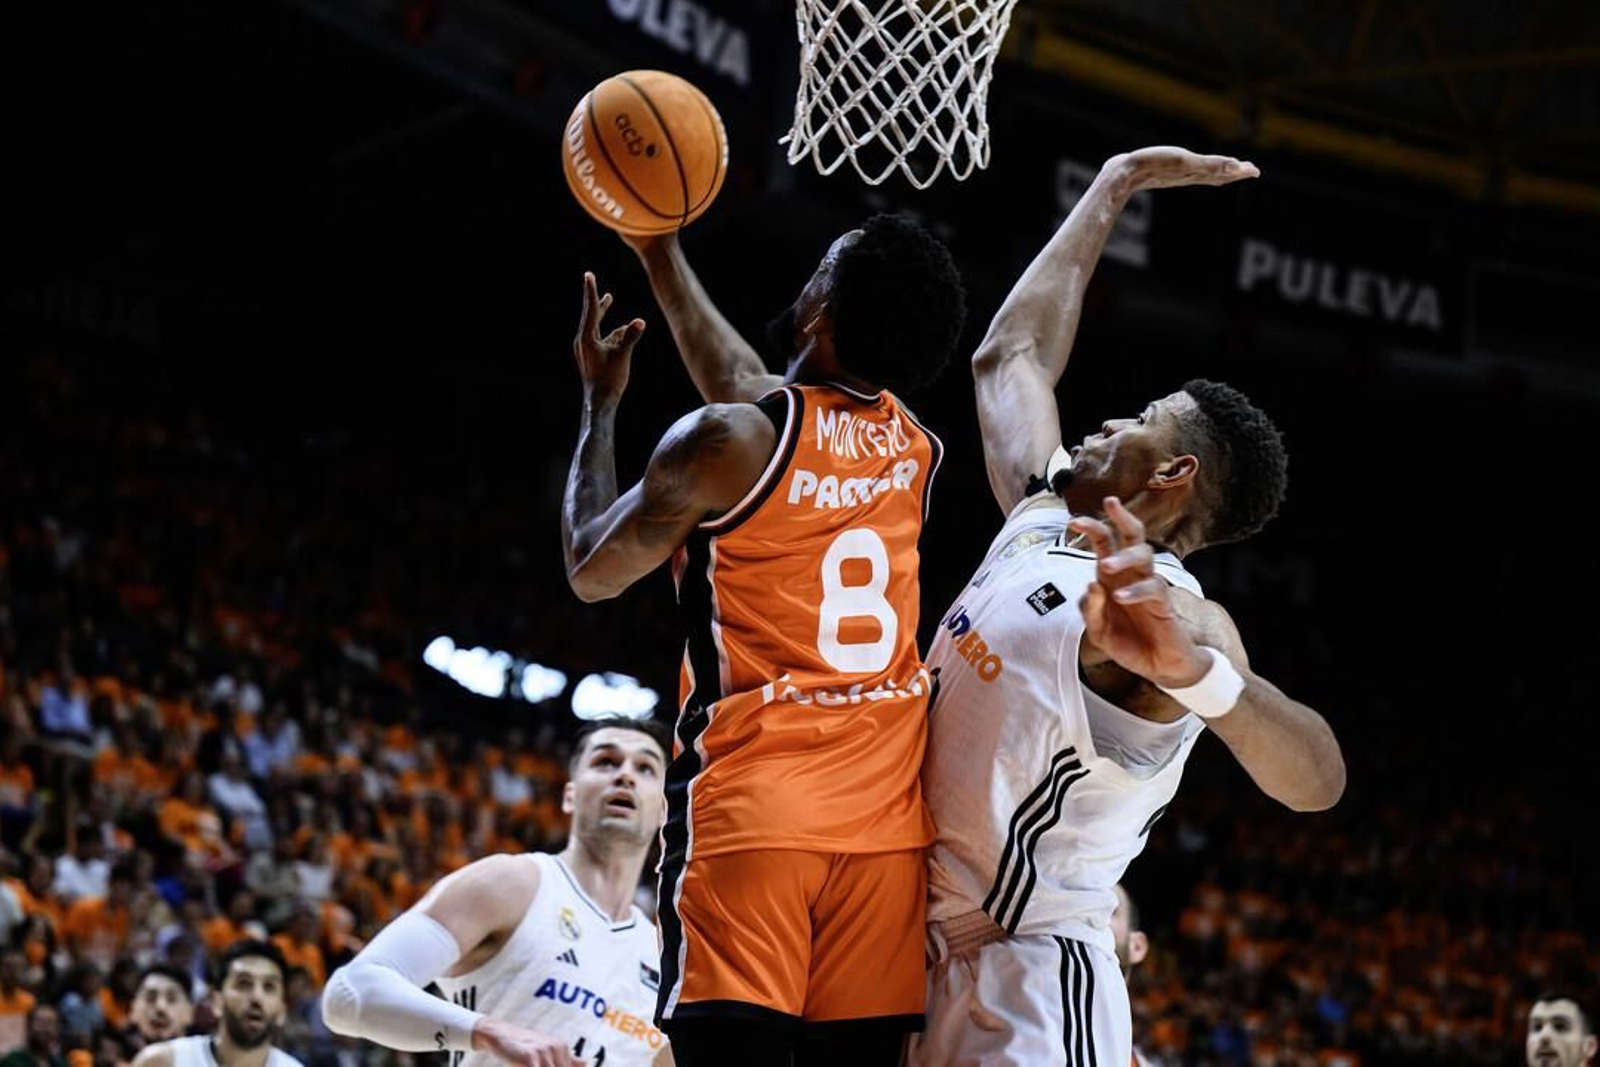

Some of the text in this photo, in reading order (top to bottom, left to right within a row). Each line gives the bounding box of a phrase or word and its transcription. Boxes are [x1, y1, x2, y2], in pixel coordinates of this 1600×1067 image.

[615, 113, 643, 157] acb
[1236, 237, 1443, 331] PULEVA
[817, 528, 898, 673] 8
[535, 977, 662, 1049] AUTOHERO
